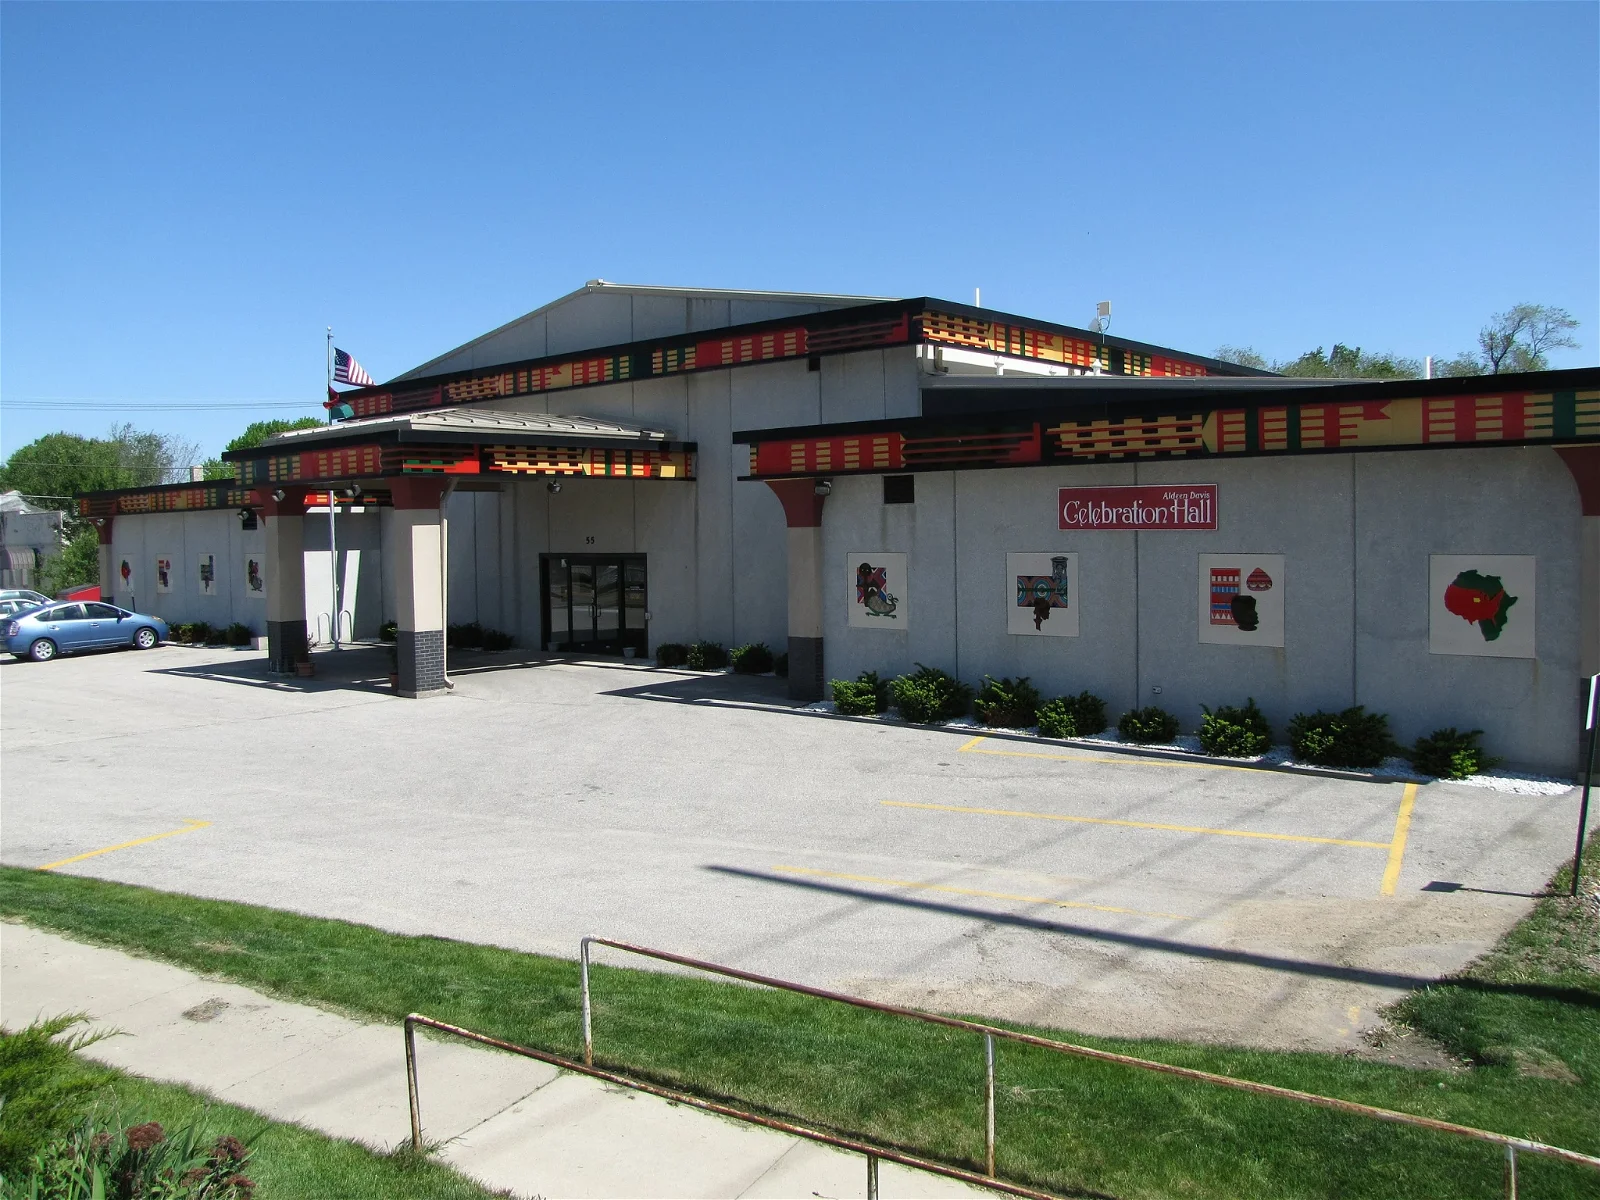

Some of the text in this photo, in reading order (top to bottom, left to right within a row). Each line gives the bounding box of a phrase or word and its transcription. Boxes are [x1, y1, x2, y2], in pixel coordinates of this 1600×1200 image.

[1162, 490, 1210, 500] Aldeen Davis
[1063, 498, 1212, 526] Celebration Hall
[586, 536, 595, 545] 55
